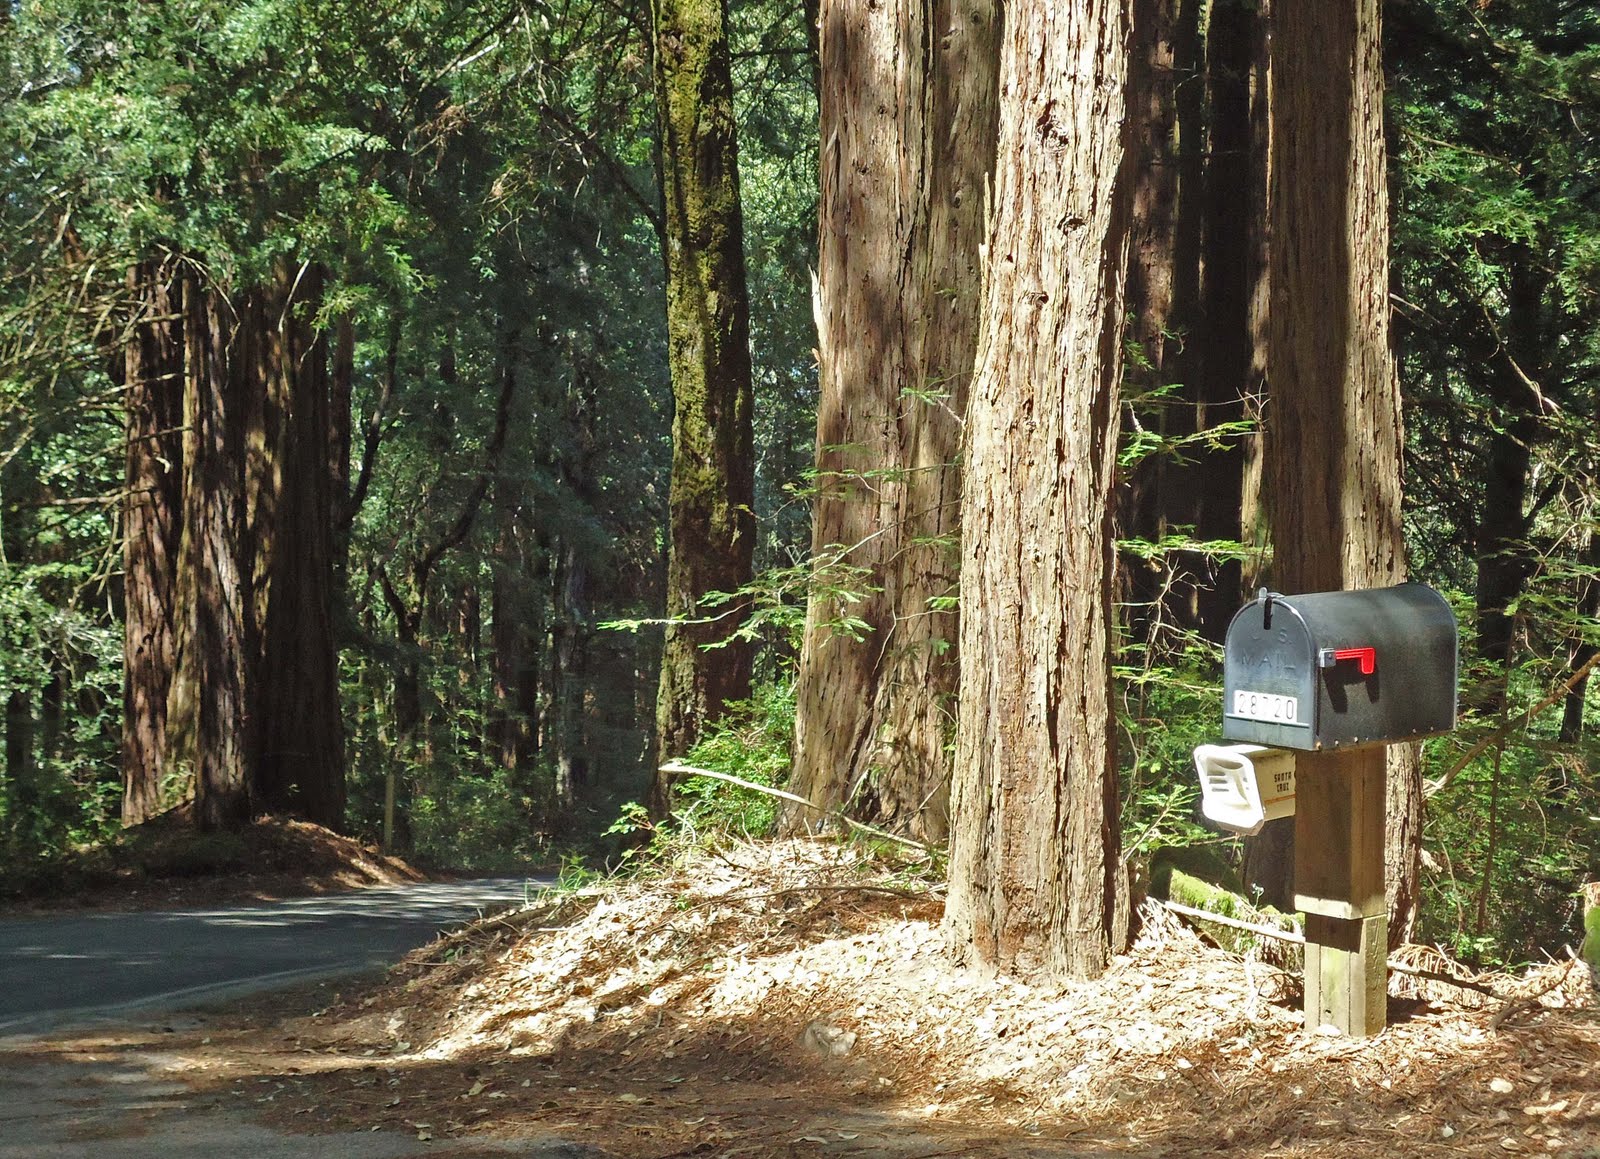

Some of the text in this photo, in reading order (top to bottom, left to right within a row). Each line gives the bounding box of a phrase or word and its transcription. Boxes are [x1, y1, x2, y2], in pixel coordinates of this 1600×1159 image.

[1241, 648, 1297, 670] MAIL
[1274, 771, 1292, 783] SANTA
[1276, 782, 1290, 793] CRUZ
